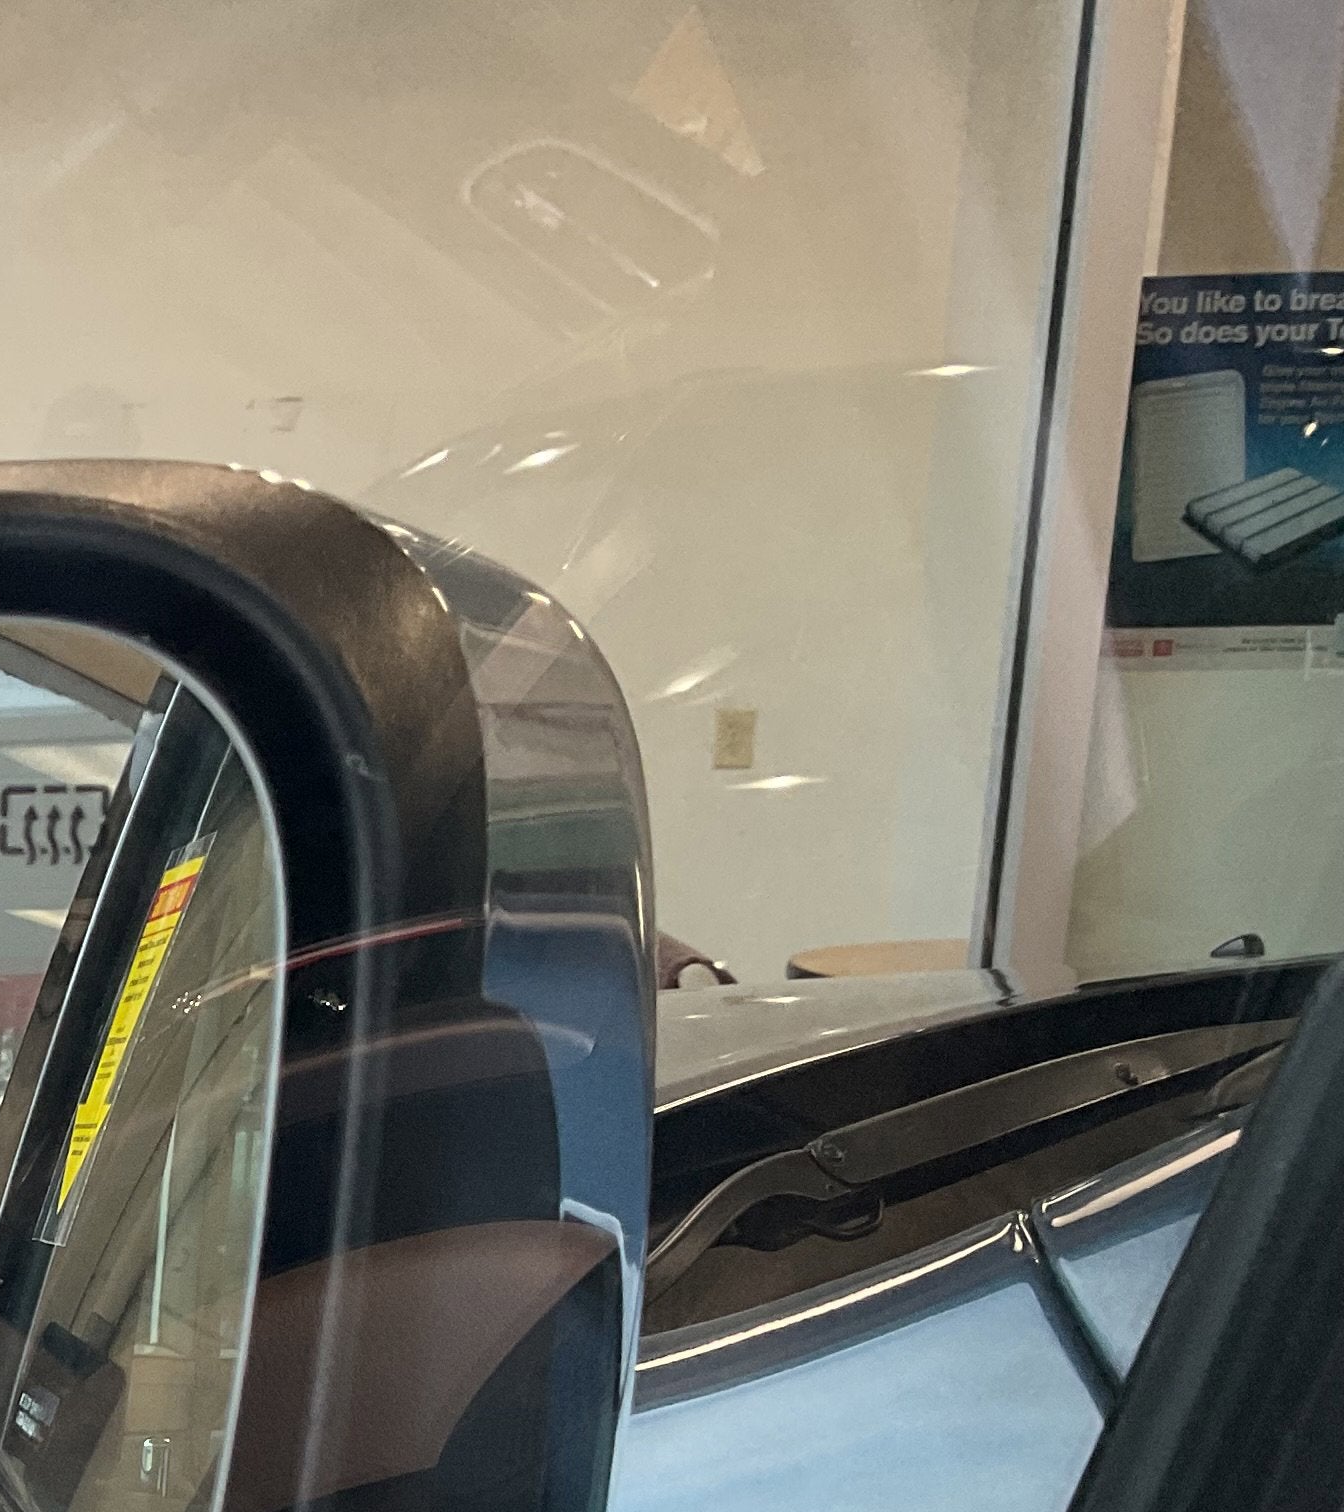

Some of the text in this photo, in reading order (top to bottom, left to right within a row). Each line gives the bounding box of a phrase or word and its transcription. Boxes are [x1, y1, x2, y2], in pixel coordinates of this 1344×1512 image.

[1196, 290, 1247, 314] like
[1254, 290, 1283, 312] to
[1137, 317, 1344, 348] So does your T
